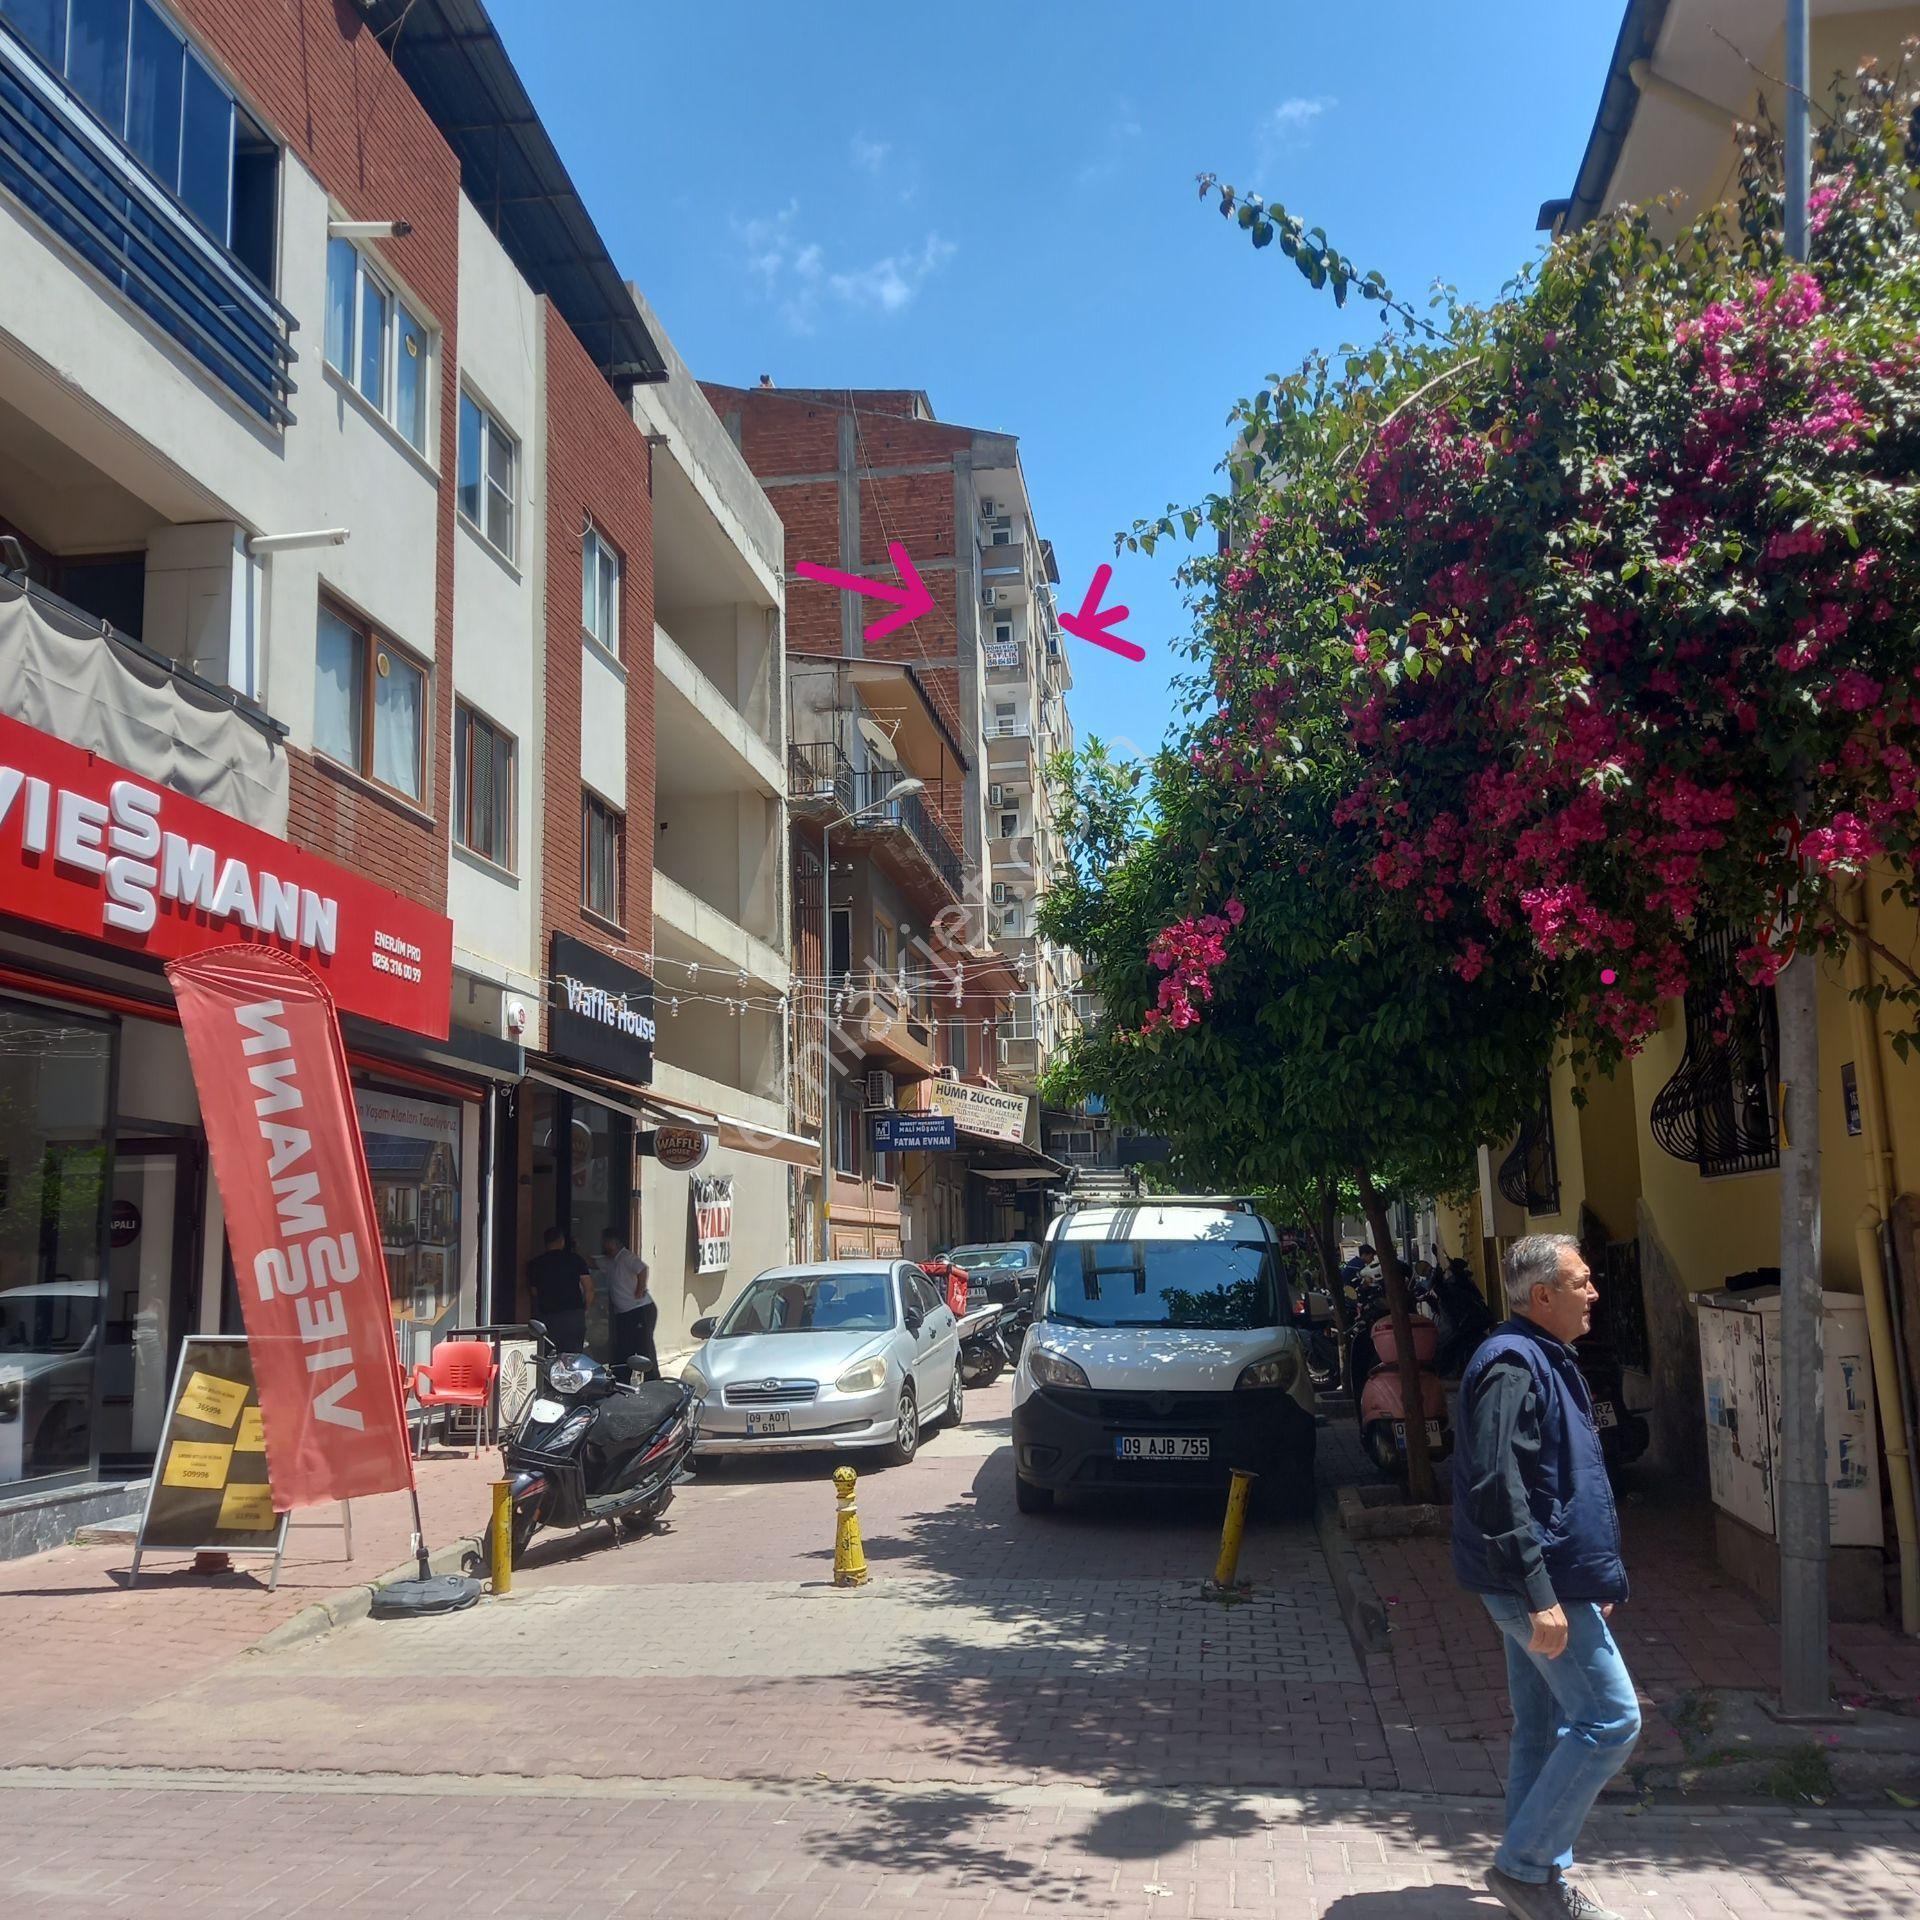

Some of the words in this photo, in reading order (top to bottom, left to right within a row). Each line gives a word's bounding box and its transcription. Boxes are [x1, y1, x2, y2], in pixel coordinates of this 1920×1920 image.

[374, 929, 406, 957] ENERJİM
[406, 943, 422, 962] PRO
[372, 951, 389, 972] 0256
[389, 958, 403, 977] 316
[403, 963, 412, 980] 00
[412, 967, 422, 983] 99
[566, 975, 615, 1027] Waffle
[617, 1001, 656, 1042] House
[935, 1082, 968, 1100] HÜMA
[899, 1125, 915, 1133] MALİ
[915, 1125, 945, 1133] MÜŞAVİR
[656, 1137, 701, 1152] WAFFLE
[894, 1137, 921, 1147] FATMA
[922, 1136, 950, 1146] EVNAN
[750, 1414, 761, 1423] 09
[770, 1412, 787, 1422] AOT
[762, 1423, 776, 1432] 611
[1123, 1438, 1141, 1455] 09
[1149, 1438, 1175, 1455] AJB
[1181, 1439, 1208, 1455] 755
